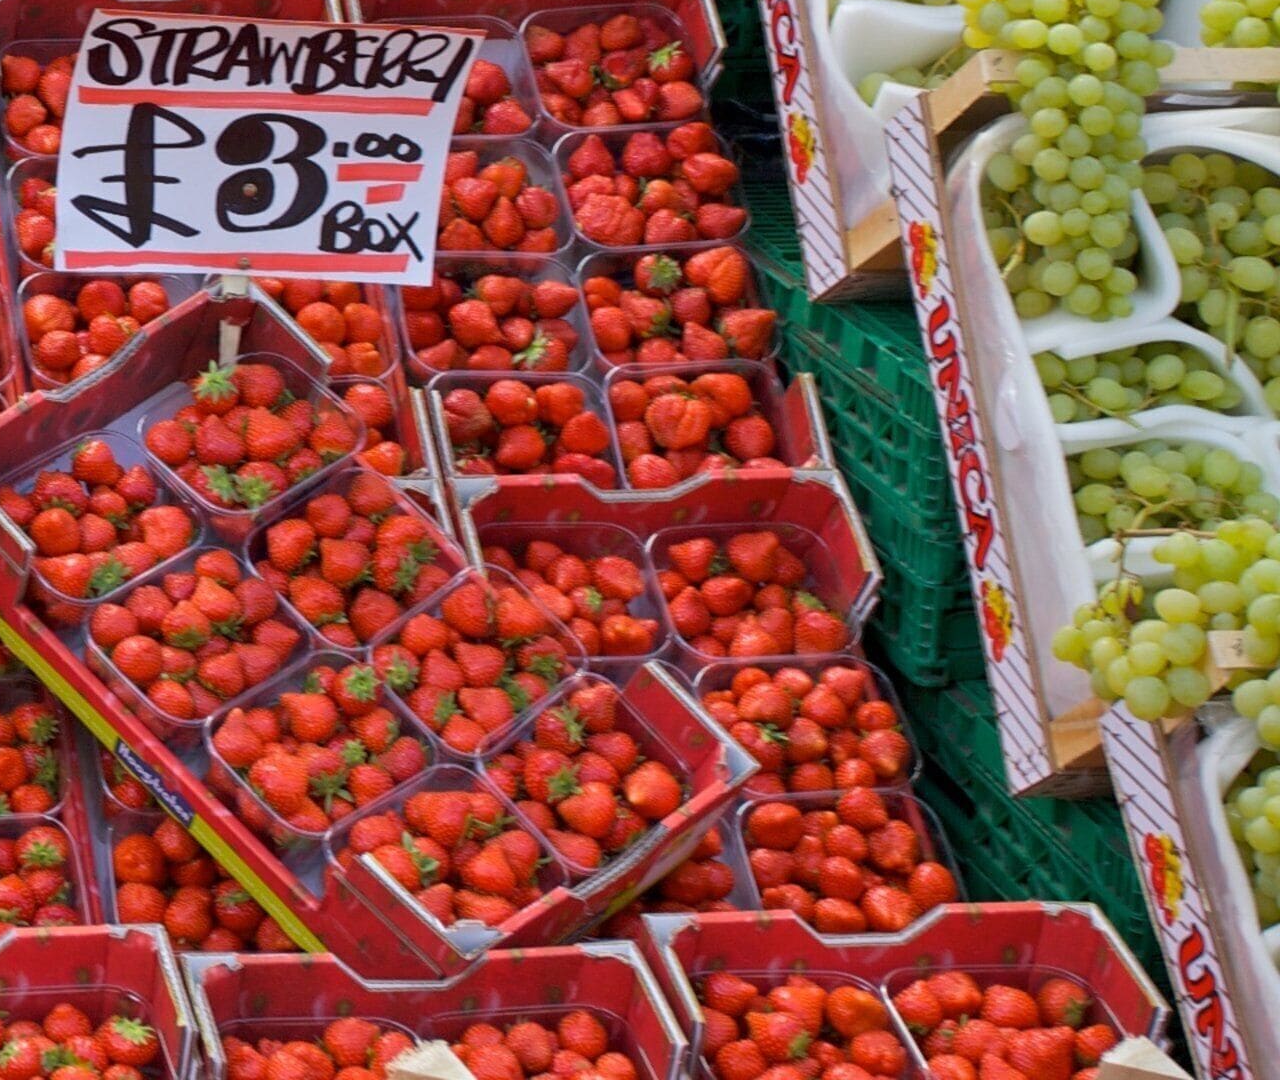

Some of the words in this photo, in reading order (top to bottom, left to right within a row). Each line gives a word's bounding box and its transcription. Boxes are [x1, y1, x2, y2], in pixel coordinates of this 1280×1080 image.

[87, 17, 475, 104] STRAWBERRY
[70, 102, 424, 249] £3.00
[318, 199, 424, 263] BOX
